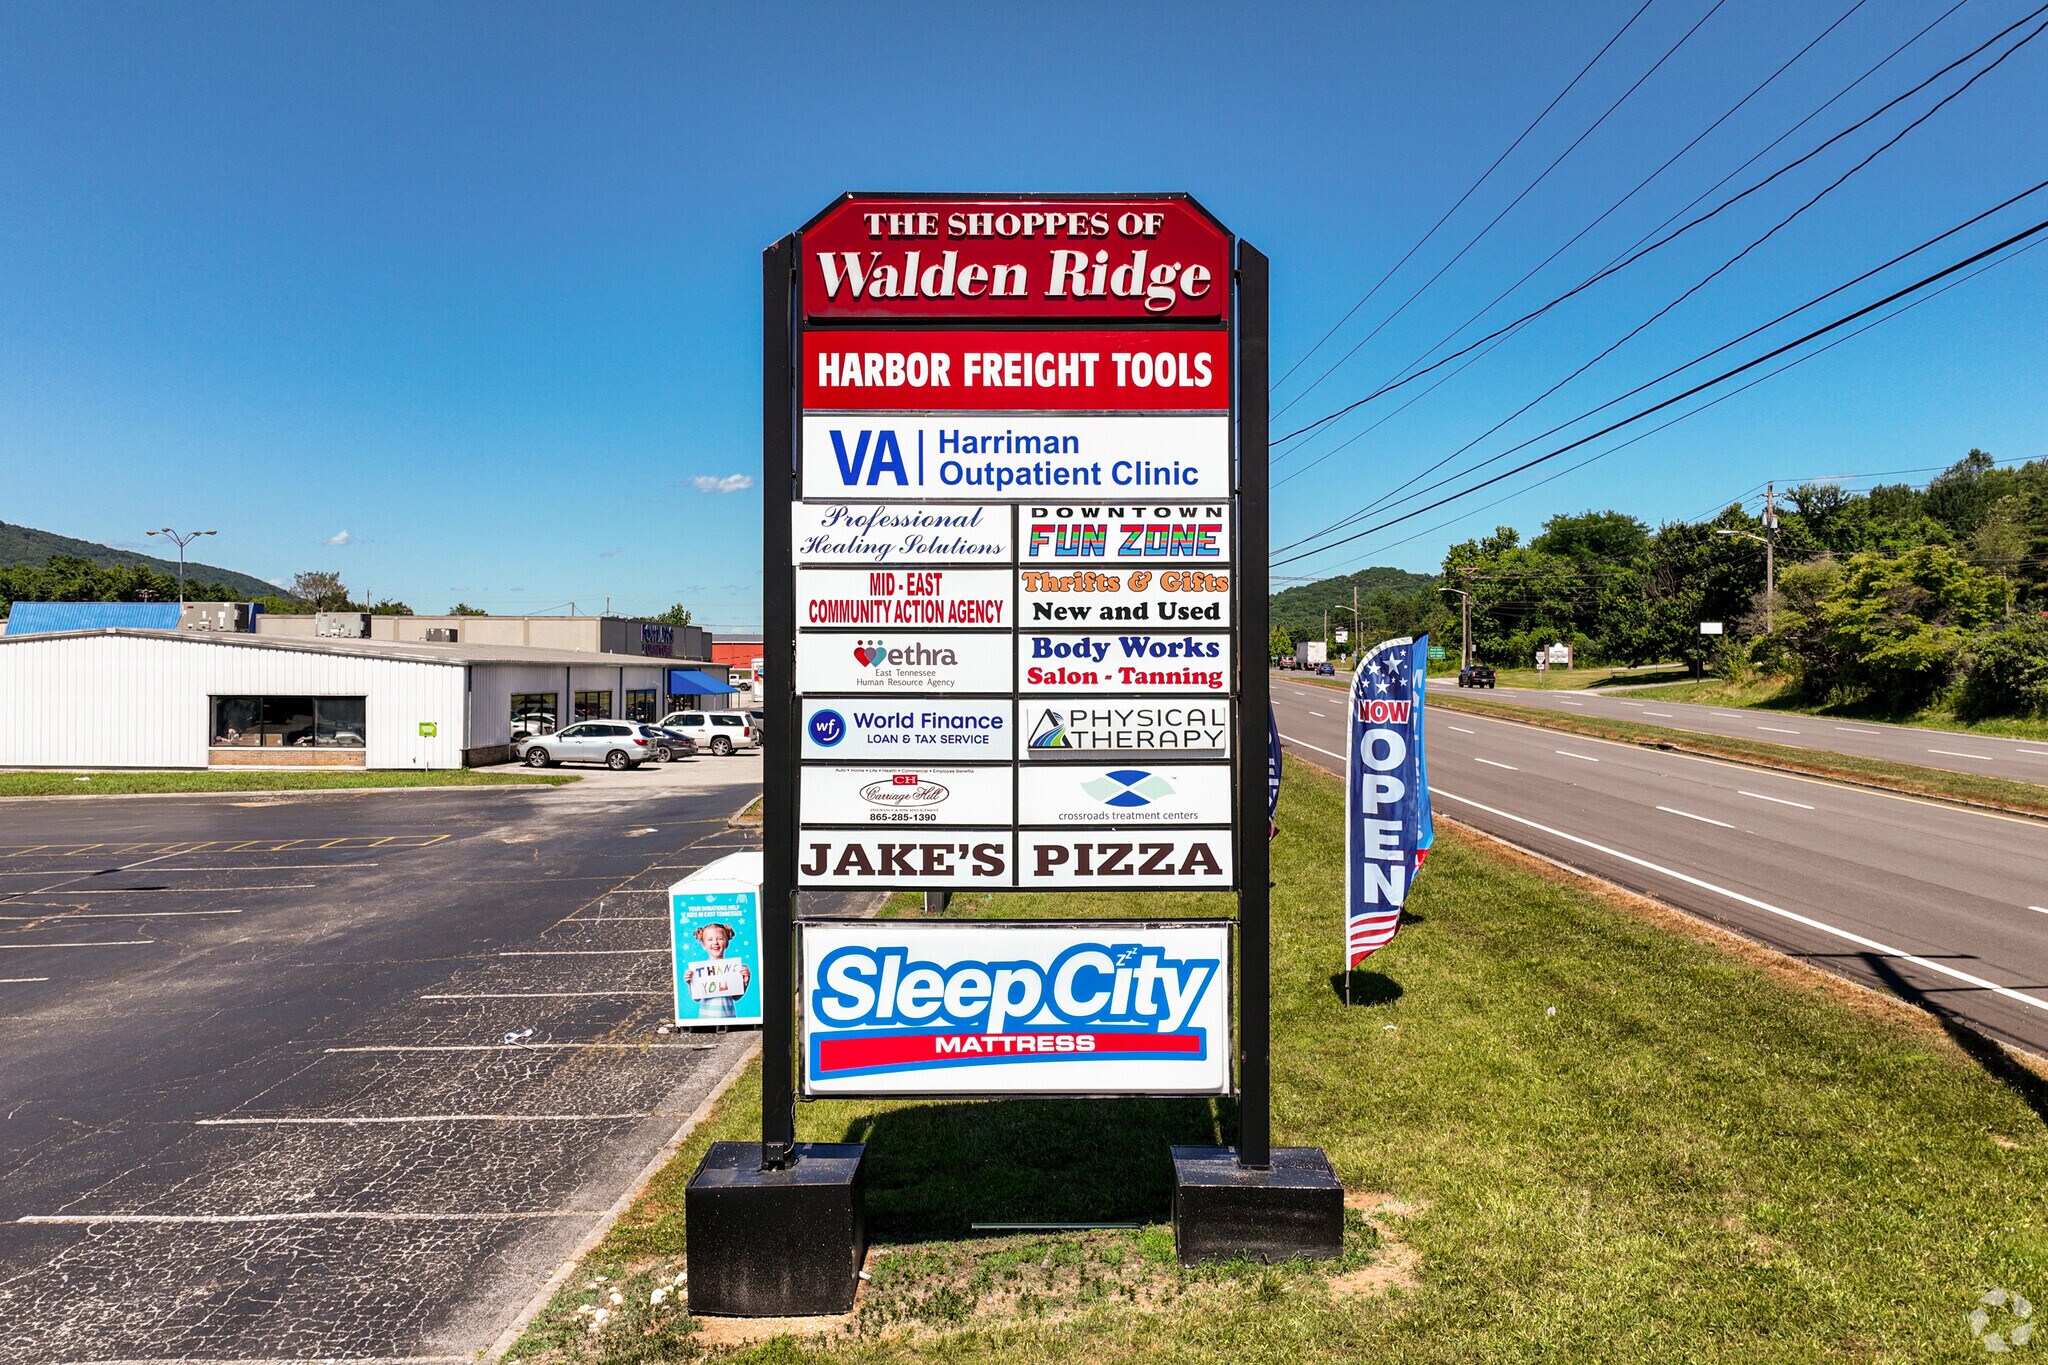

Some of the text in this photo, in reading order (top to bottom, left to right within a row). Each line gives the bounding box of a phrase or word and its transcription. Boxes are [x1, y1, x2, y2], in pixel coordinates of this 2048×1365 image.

[864, 212, 1164, 236] THE SHOPPES OF
[817, 249, 1211, 311] Walden Ridge
[818, 352, 1213, 387] HARBOR FREIGHT TOOLS
[939, 429, 1080, 454] Harriman
[829, 430, 908, 486] VA
[940, 460, 1199, 491] Outpatient Clinic
[821, 505, 983, 536] Professional
[1031, 507, 1222, 518] DOWNTOWN
[800, 534, 1006, 561] Healing Solutions
[1029, 524, 1222, 557] FUN ZONE
[869, 573, 895, 596] MID
[906, 573, 942, 596] EAST
[1022, 571, 1229, 592] Thrifts & Gifts
[808, 600, 1003, 623] COMMUNITY ACTION AGENCY
[1032, 602, 1221, 620] New and Used
[887, 641, 958, 666] ethra
[1032, 637, 1220, 662] Body Works
[856, 678, 955, 688] Human Resource Agency
[1027, 667, 1099, 685] Salon
[1118, 667, 1223, 689] Tanning
[853, 712, 1004, 729] World Finance
[1070, 708, 1226, 727] PHYSICAL
[1357, 700, 1412, 724] NOW
[815, 719, 835, 735] wf
[867, 734, 989, 744] LOAN & TAX SERVICE
[1071, 730, 1224, 748] THERAPY
[893, 776, 917, 784] CH
[866, 786, 944, 805] Carriage Hill
[869, 813, 937, 822] 865-285-1390
[1058, 811, 1199, 821] crossroads treatment centers
[1360, 728, 1406, 906] OPEN
[801, 843, 1222, 877] JAKE'S PIZZA
[702, 980, 729, 995] YOU
[935, 1035, 1096, 1053] MATTRESS
